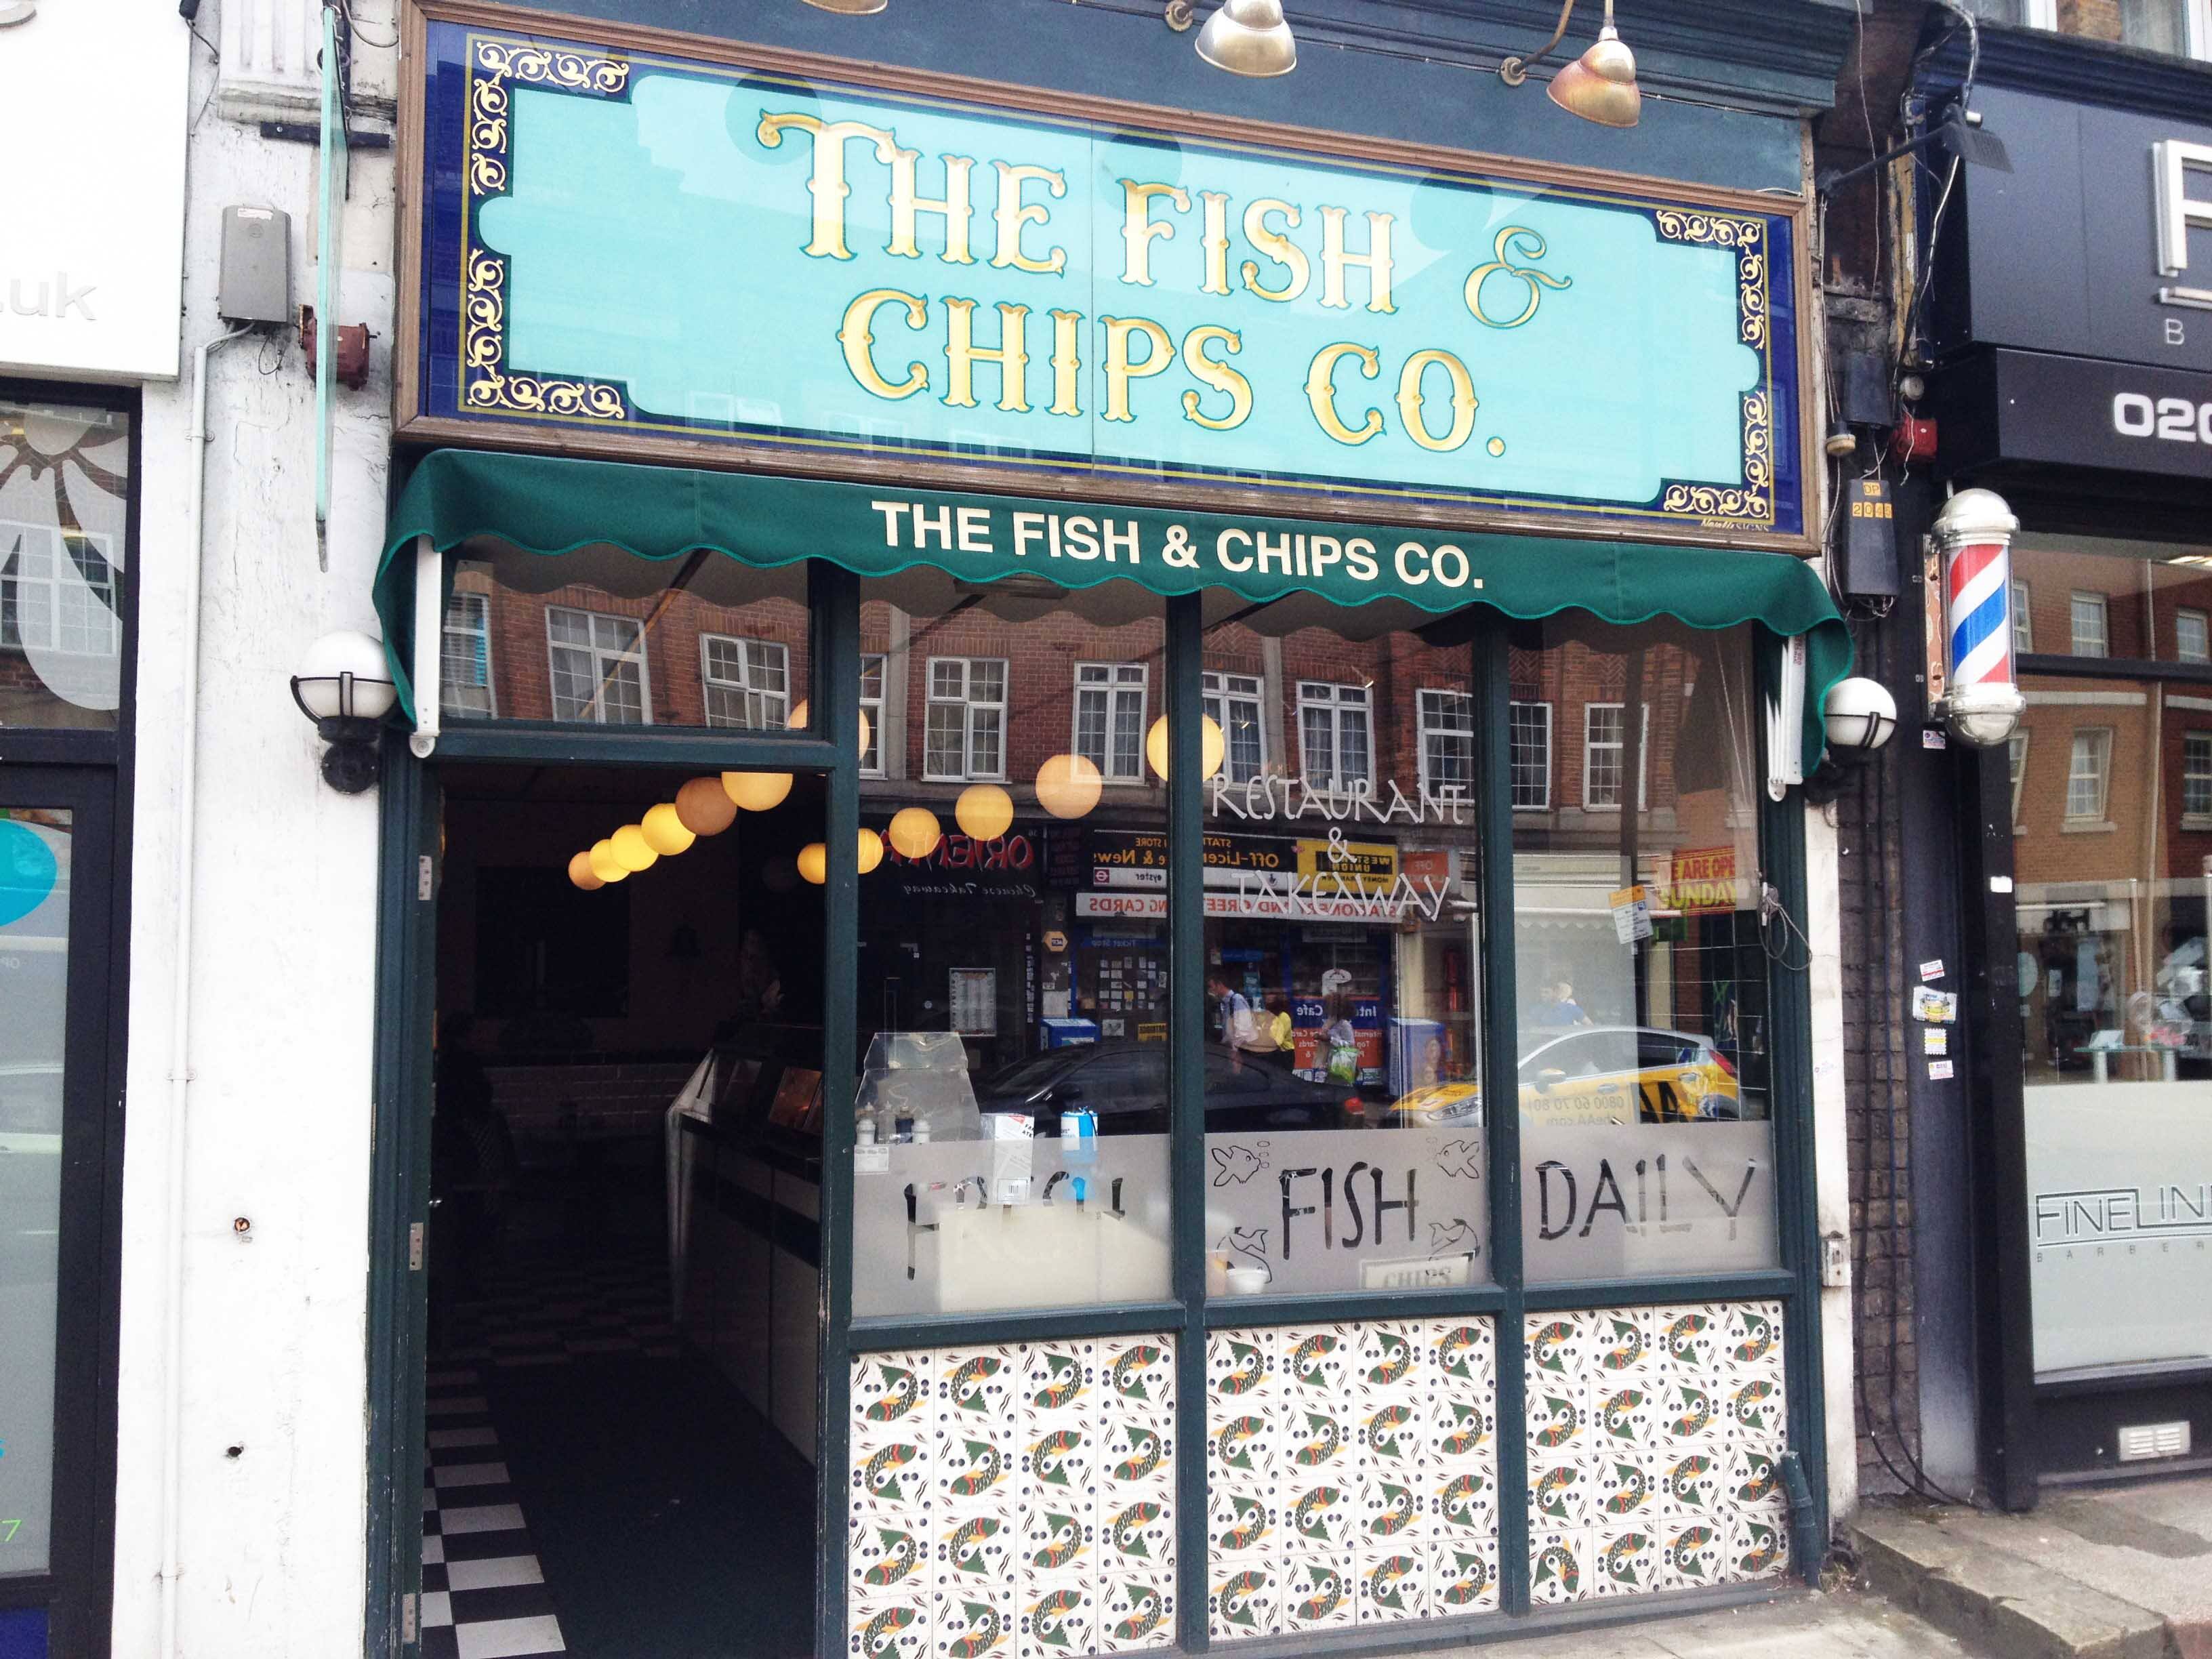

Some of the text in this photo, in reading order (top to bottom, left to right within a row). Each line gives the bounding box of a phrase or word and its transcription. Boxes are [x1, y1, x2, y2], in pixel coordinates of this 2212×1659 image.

[757, 108, 1572, 329] THE FISH &
[835, 288, 1505, 457] CHIPS CO.
[872, 500, 1483, 590] THE FISH & CHIPS CO.
[1212, 773, 1467, 825] RESTAURANT
[1327, 826, 1357, 865] &
[1231, 870, 1450, 922] TAKEAWAY
[1279, 1153, 1757, 1261] FISH DAILY
